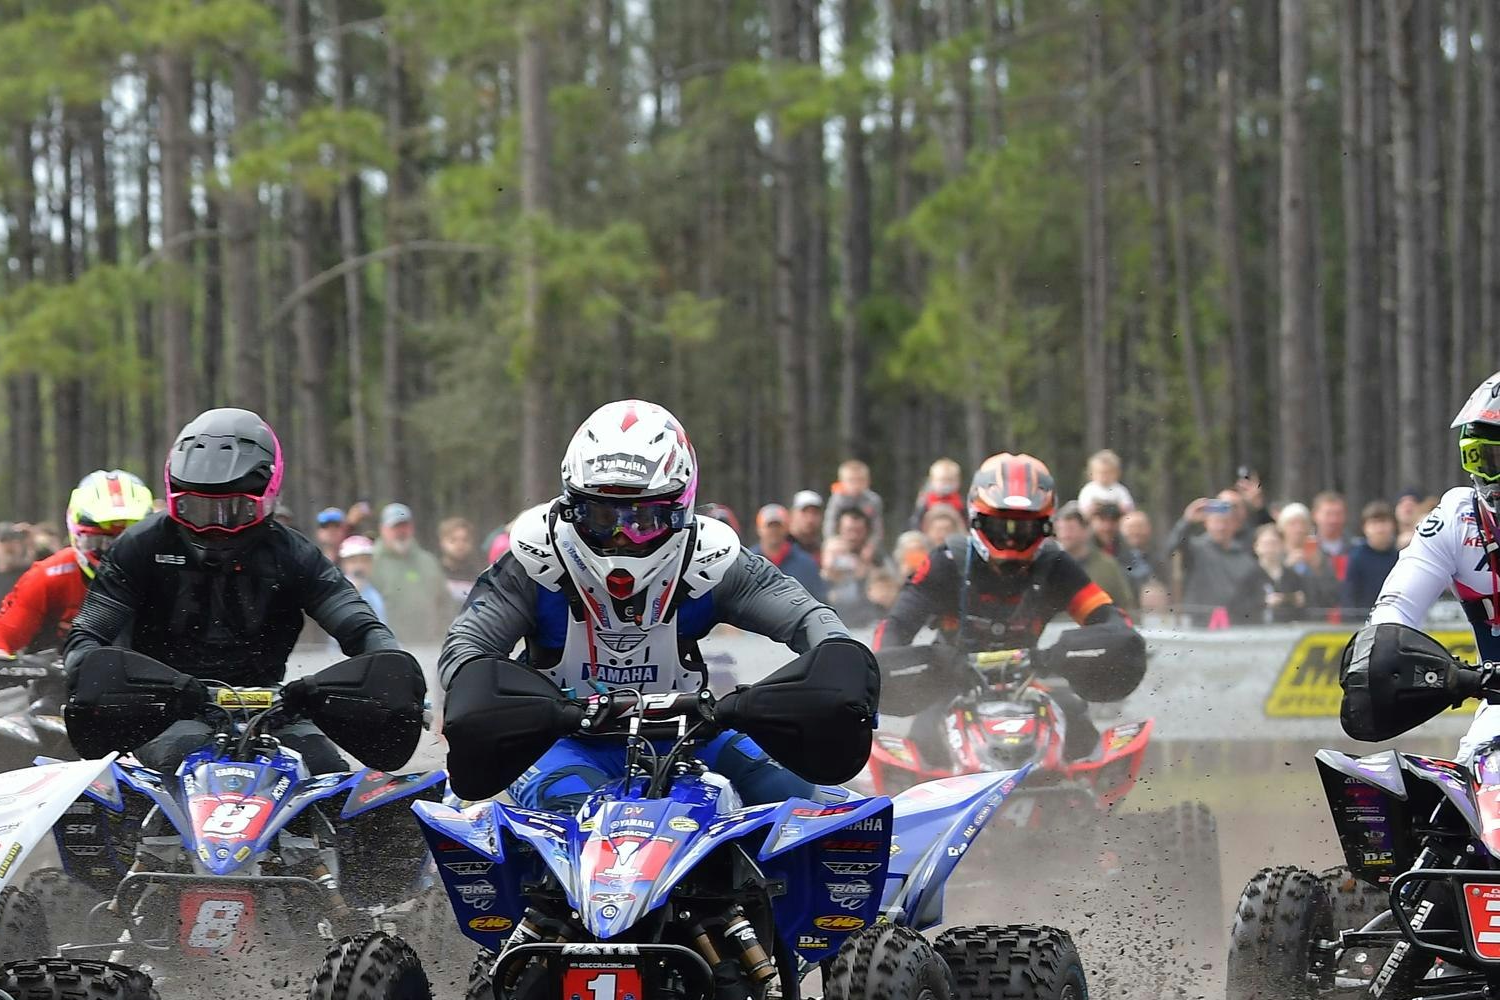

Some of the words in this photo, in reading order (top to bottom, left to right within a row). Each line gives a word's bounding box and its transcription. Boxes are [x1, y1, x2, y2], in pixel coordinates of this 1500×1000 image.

[602, 459, 648, 475] YAMAHA
[518, 540, 553, 559] FLY
[694, 546, 732, 564] FLY
[567, 545, 587, 573] YAMAHA
[991, 719, 1027, 733] 4
[201, 802, 262, 834] 8
[620, 819, 655, 830] YAMAHA
[602, 840, 641, 876] 1
[1363, 852, 1393, 861] DP
[461, 884, 497, 895] BNR
[830, 883, 873, 894] BNR
[188, 900, 245, 948] 8
[470, 918, 513, 929] FMF
[817, 916, 865, 928] FMF
[561, 943, 640, 955] RATH
